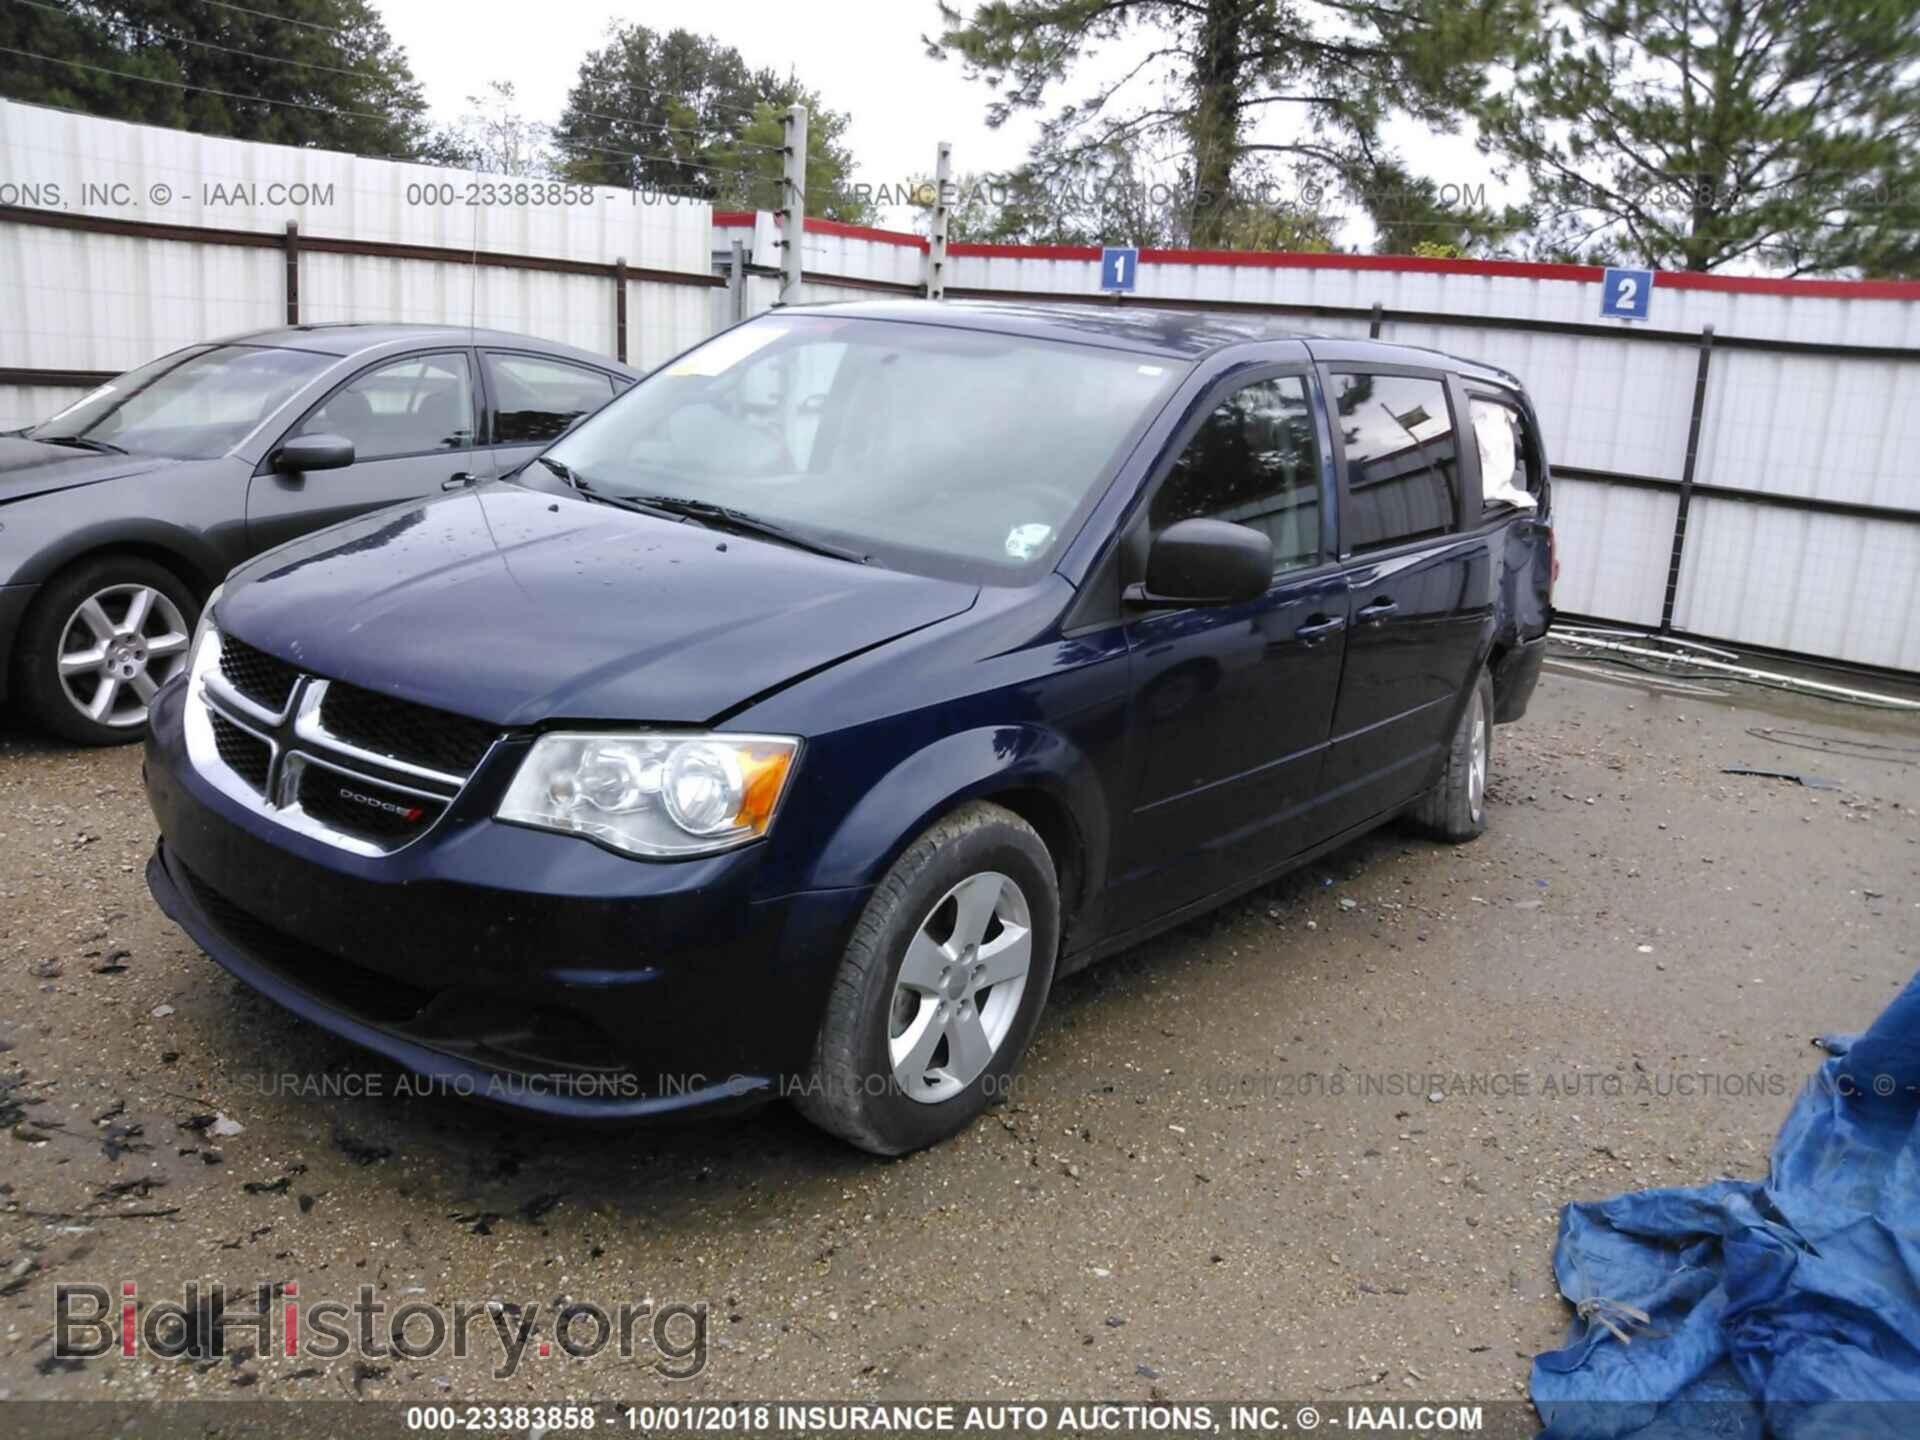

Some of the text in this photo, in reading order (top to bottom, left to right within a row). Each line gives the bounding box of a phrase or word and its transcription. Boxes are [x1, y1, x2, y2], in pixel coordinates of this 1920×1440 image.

[1114, 255, 1125, 283] 1
[1615, 278, 1637, 309] 2
[340, 788, 411, 817] DODGE
